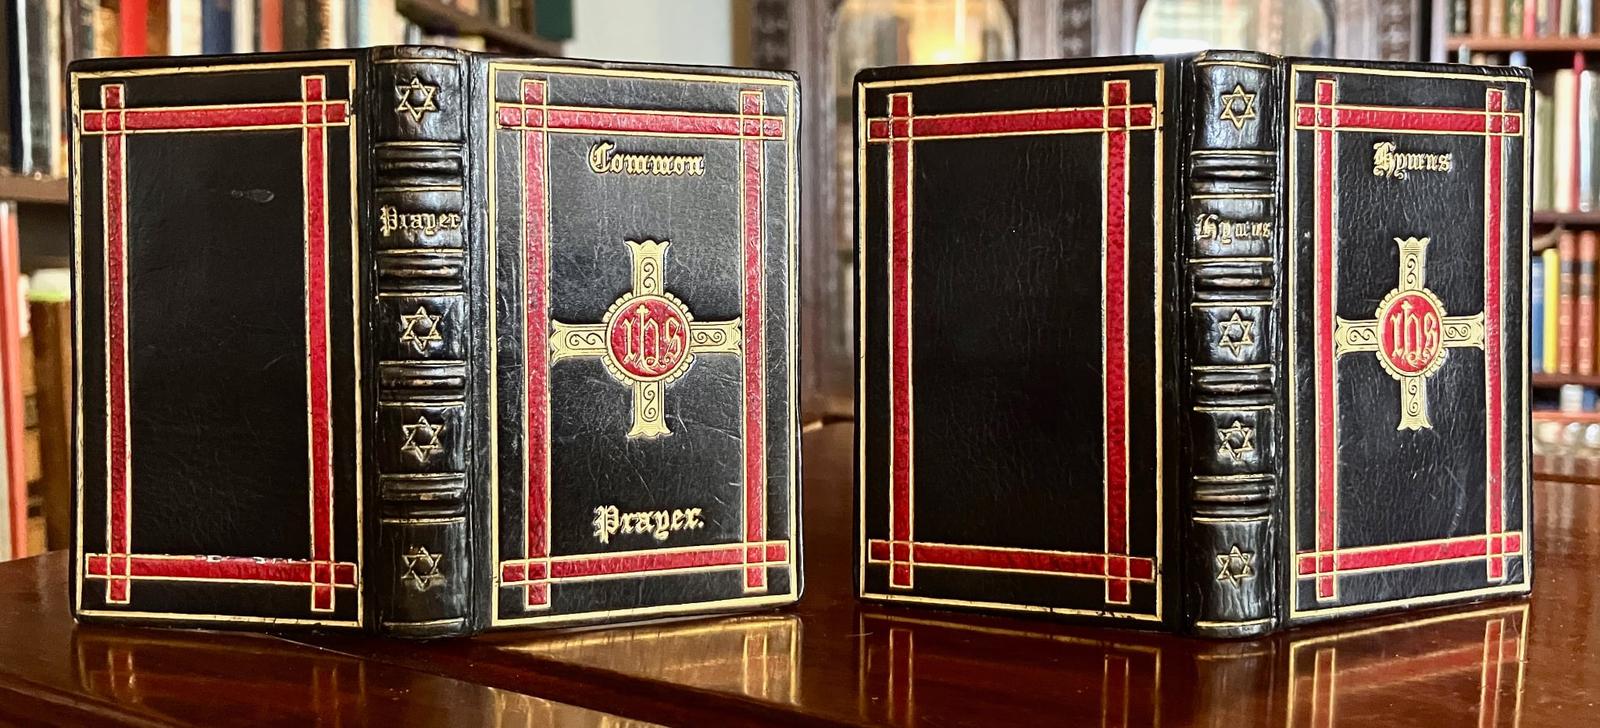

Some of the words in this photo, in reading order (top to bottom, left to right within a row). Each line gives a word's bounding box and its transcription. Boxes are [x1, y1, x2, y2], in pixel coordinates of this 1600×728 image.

[589, 142, 704, 175] Common
[1373, 141, 1453, 180] Hymns
[380, 204, 461, 237] Prayer
[1194, 213, 1271, 244] Hymns
[592, 504, 704, 544] Prayer.
